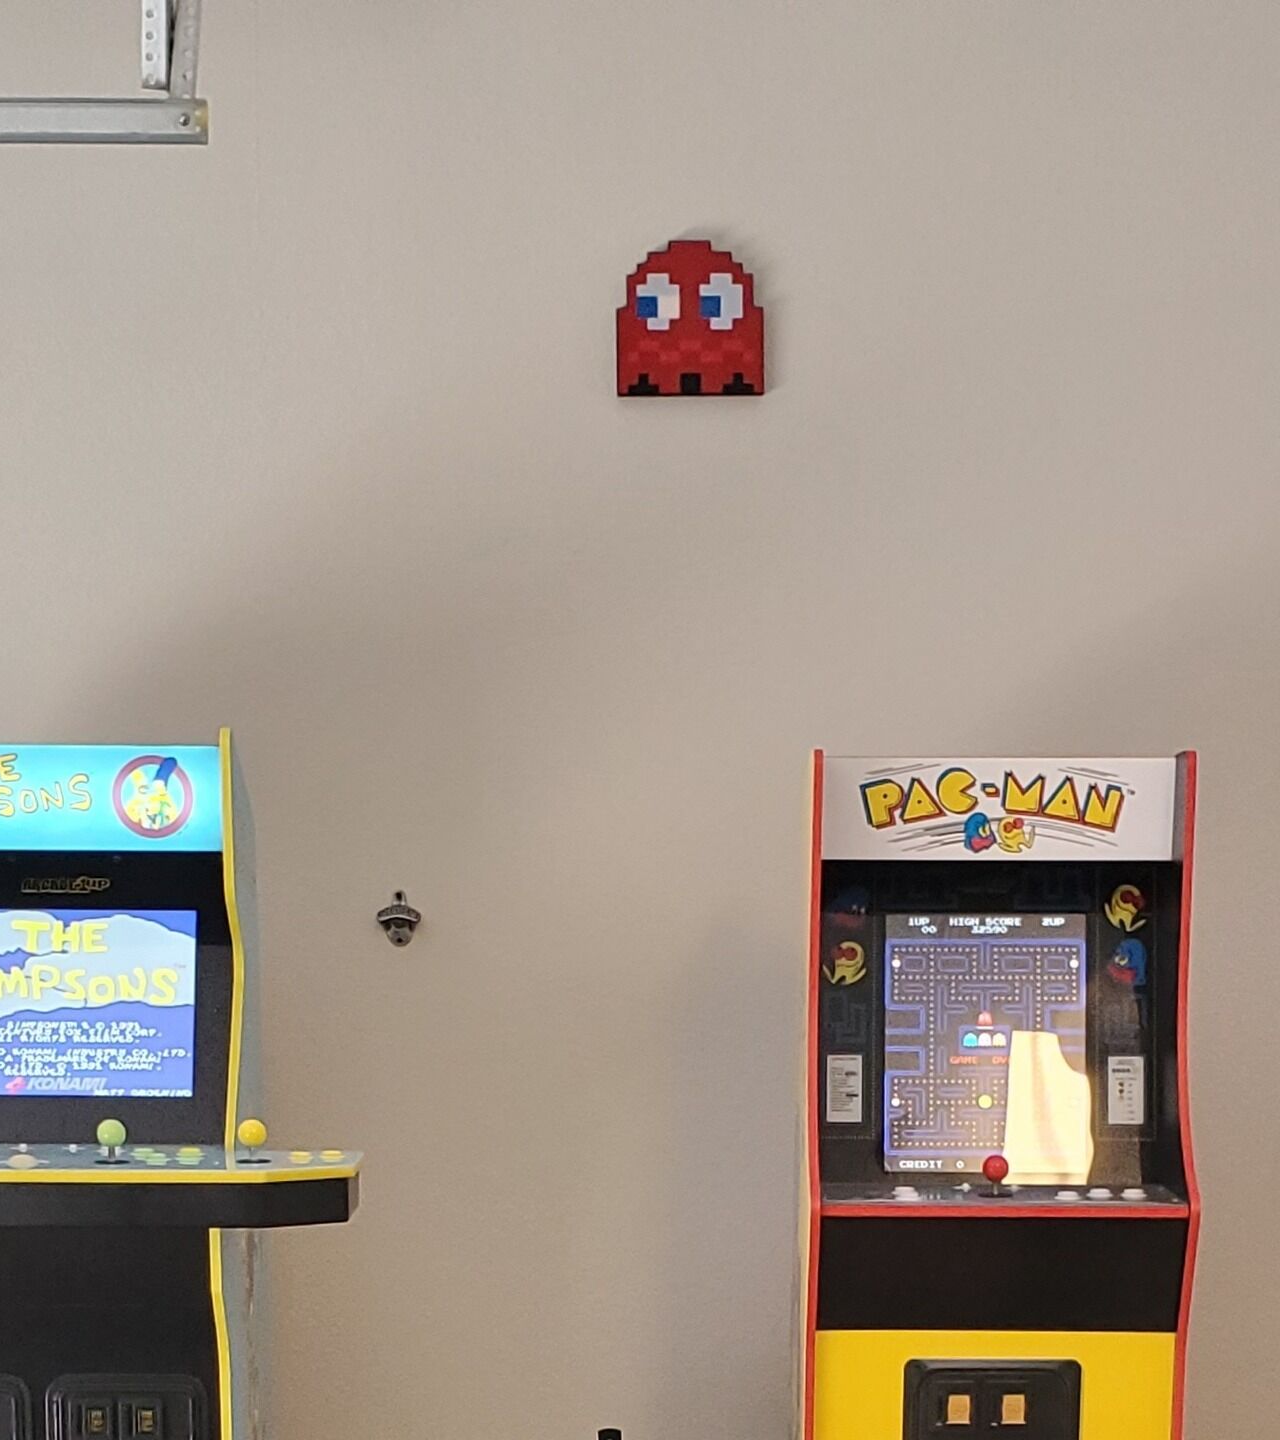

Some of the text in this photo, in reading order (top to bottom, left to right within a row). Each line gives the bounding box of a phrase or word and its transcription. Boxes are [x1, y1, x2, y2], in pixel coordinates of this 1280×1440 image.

[859, 767, 1126, 833] PAC-MAN
[11, 920, 110, 953] THE
[27, 1077, 107, 1091] KONAMI
[899, 1160, 943, 1169] CREDIT
